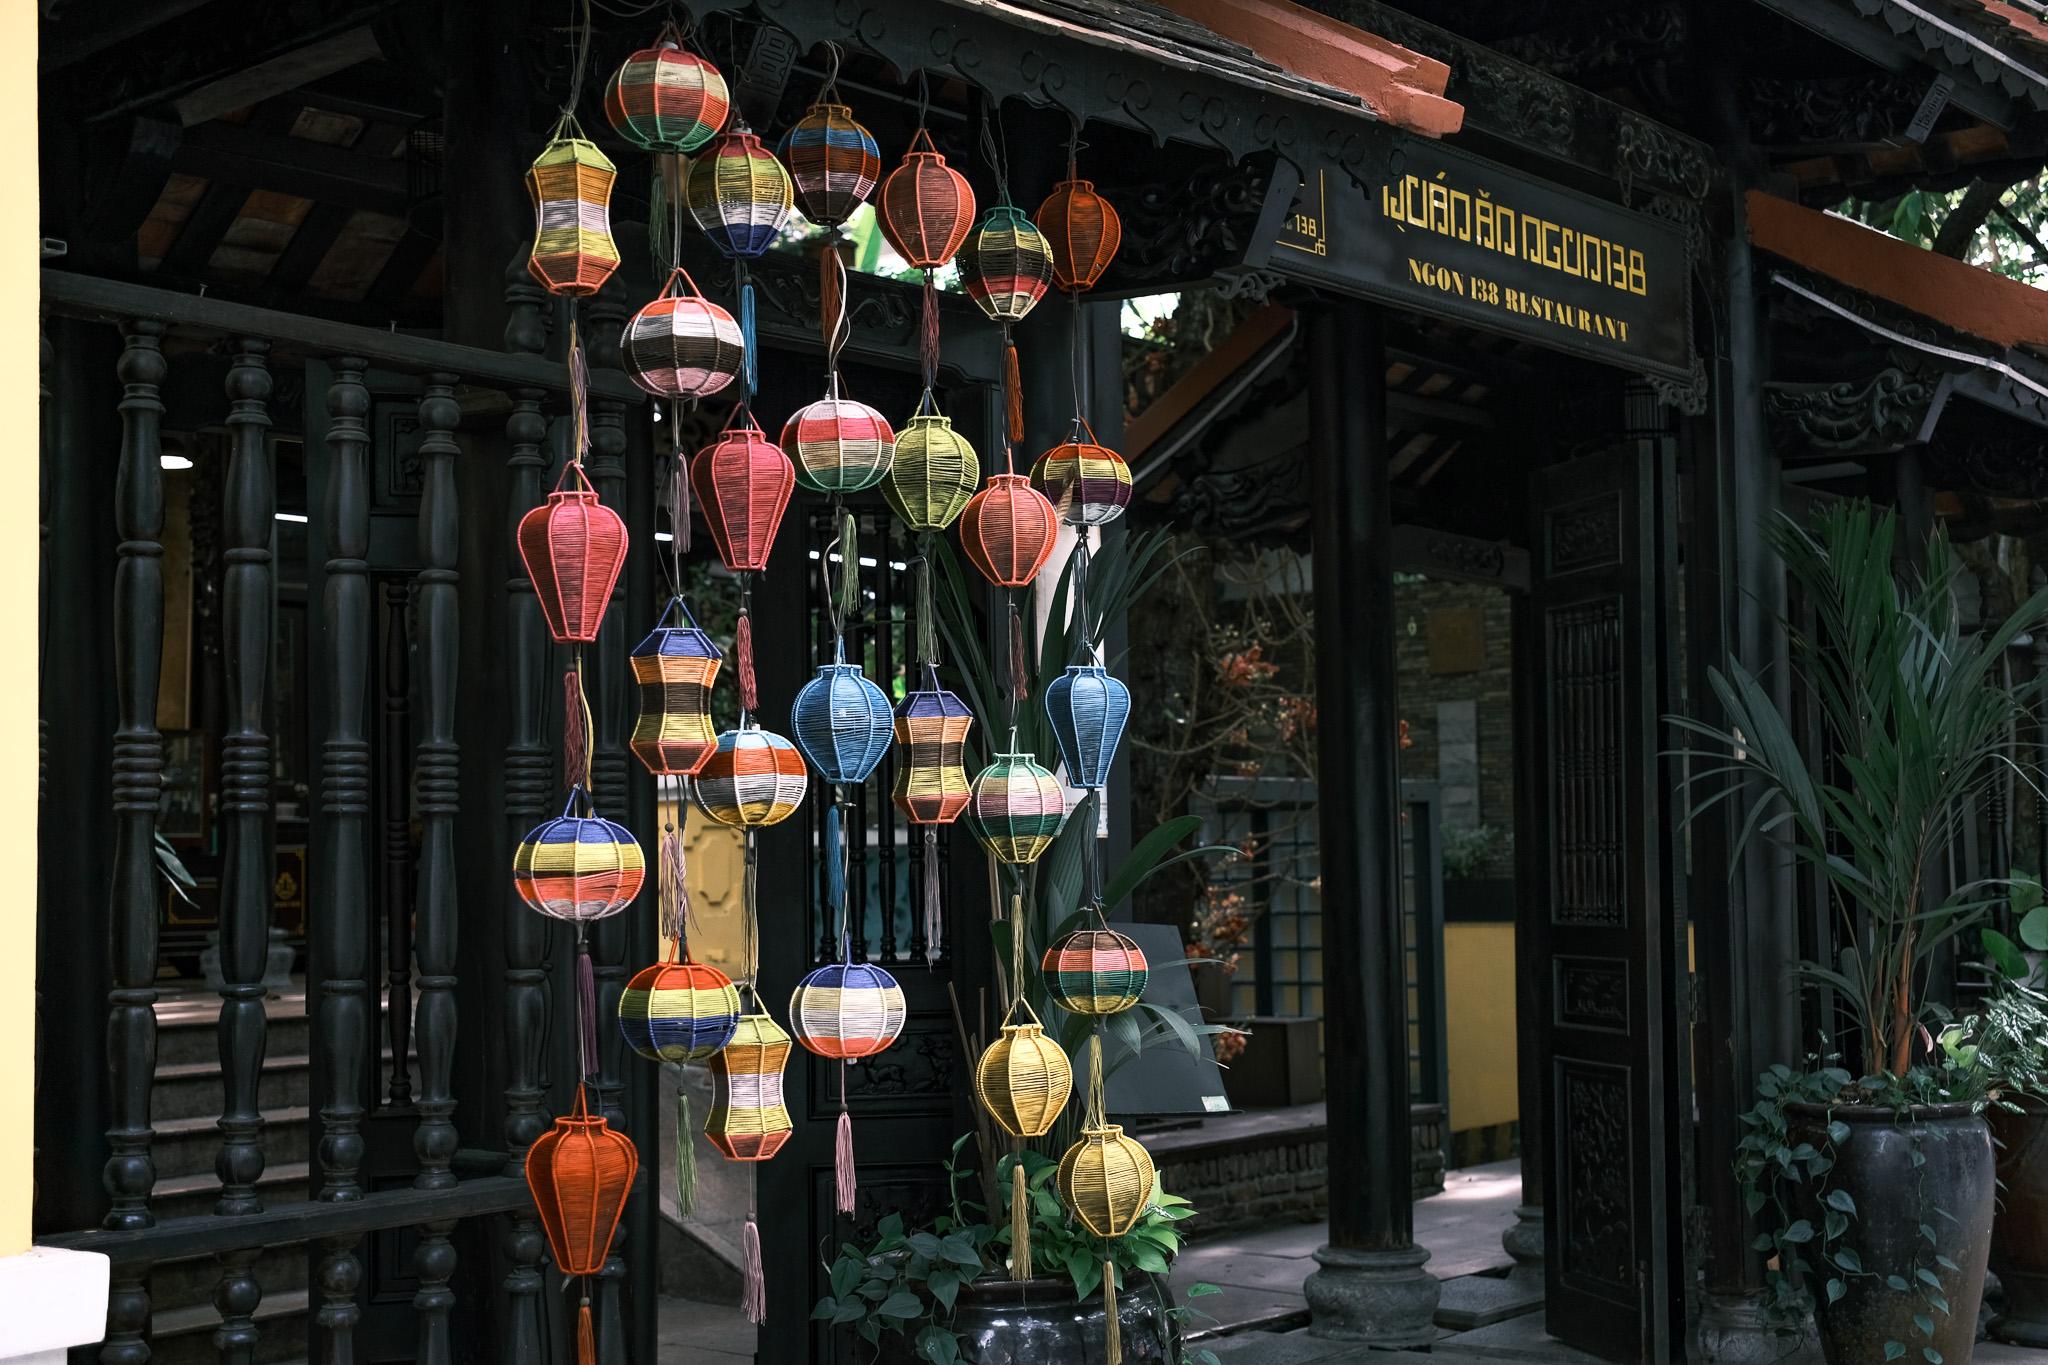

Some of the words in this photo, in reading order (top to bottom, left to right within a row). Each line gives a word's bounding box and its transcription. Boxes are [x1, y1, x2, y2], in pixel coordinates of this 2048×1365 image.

[1408, 257, 1464, 296] NGON
[1470, 276, 1499, 305] 138
[1505, 287, 1630, 342] RESTAURANT
